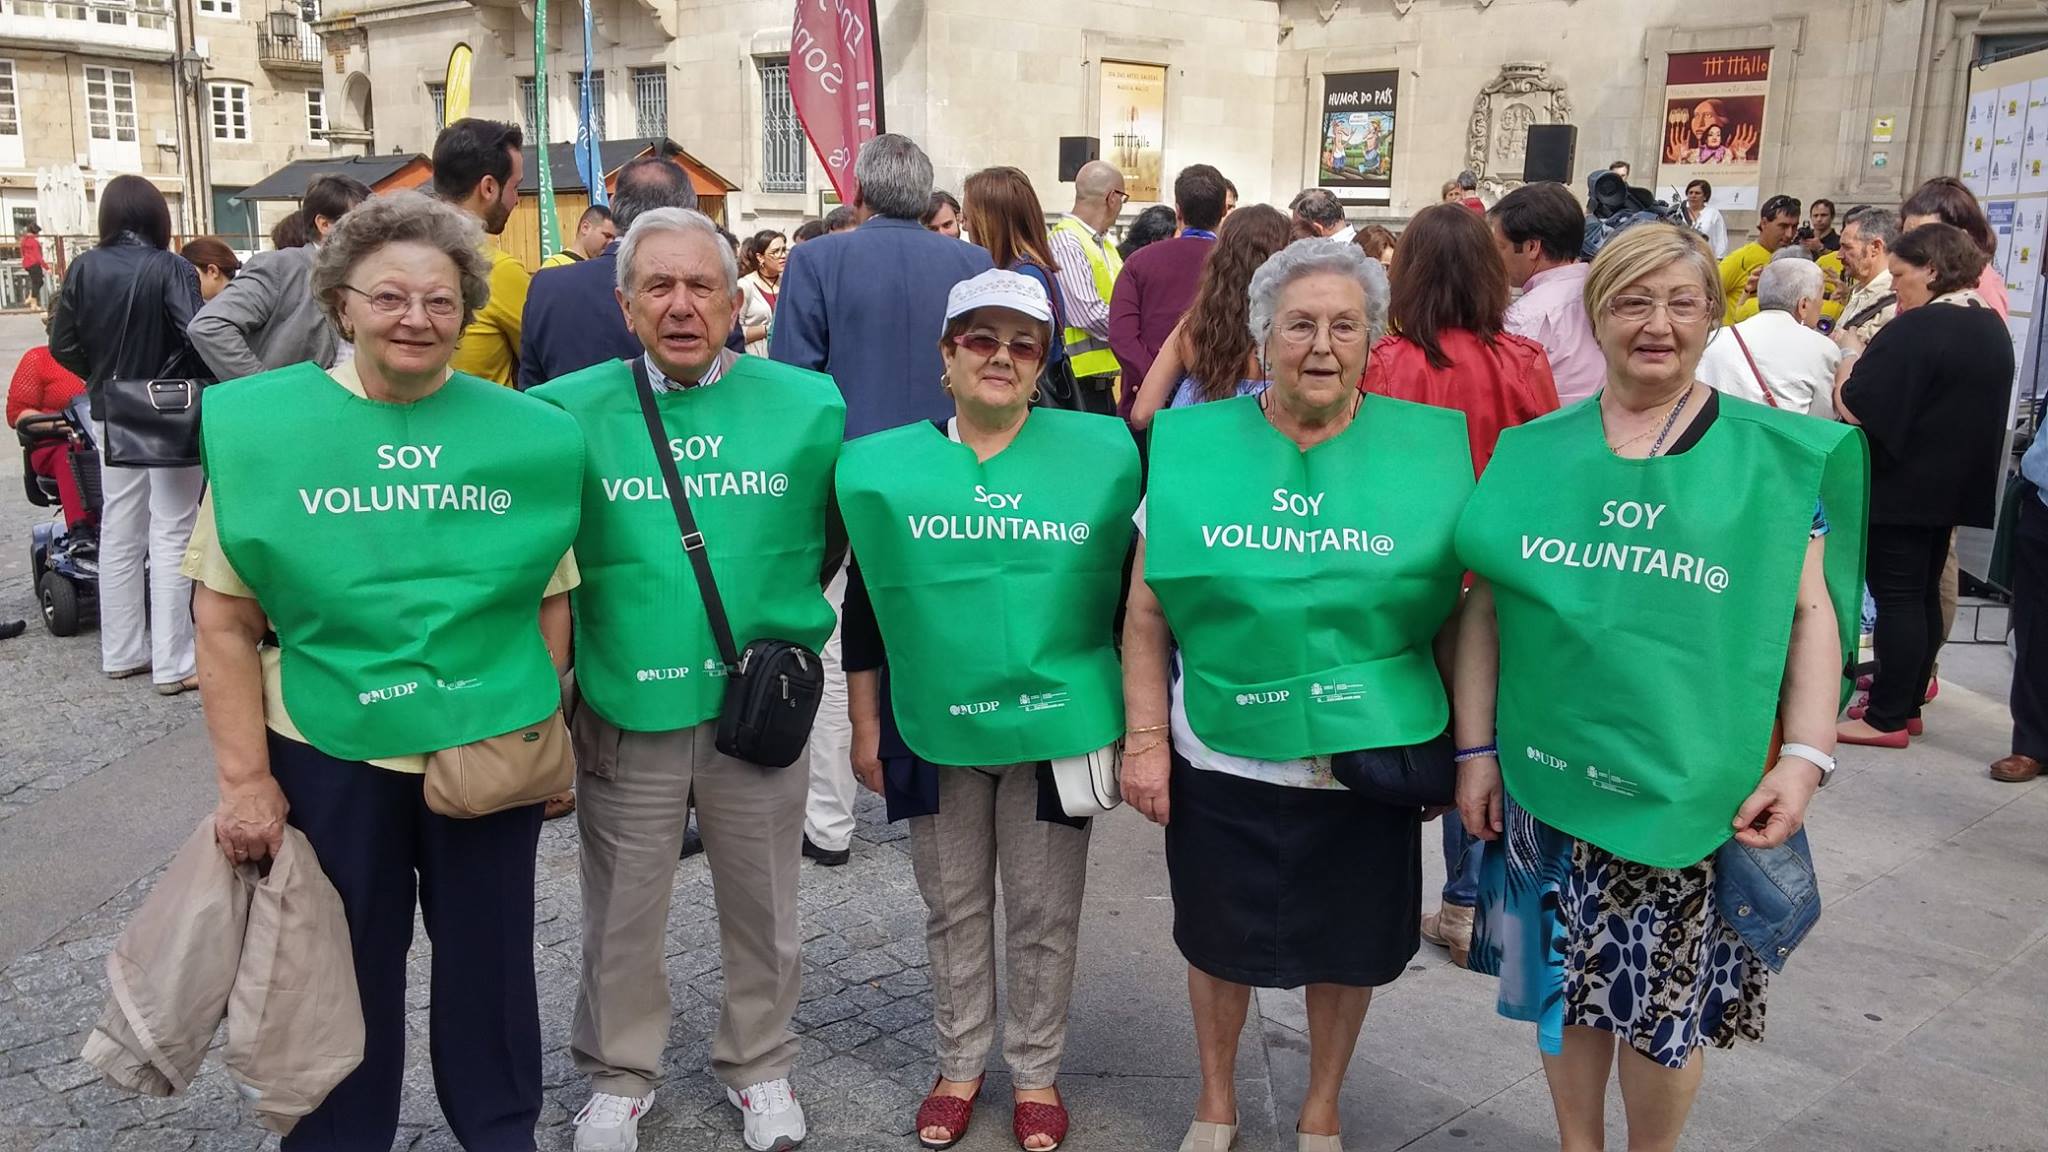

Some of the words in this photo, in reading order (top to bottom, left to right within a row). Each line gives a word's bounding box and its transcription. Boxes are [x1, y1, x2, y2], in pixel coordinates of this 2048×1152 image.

[1328, 90, 1359, 106] HUMOR
[1360, 91, 1372, 105] DO
[376, 444, 443, 470] SOY
[668, 435, 724, 462] SOY
[298, 483, 512, 515] VOLUNTARI@
[973, 484, 1023, 510] SOY
[1271, 487, 1326, 517] SOY
[1598, 499, 1667, 531] SOY
[907, 515, 1090, 546] VOLUNTARI@
[1201, 523, 1395, 557] VOLUNTARI@
[1520, 534, 1730, 594] VOLUNTARI@
[655, 667, 689, 680] UDP
[378, 681, 418, 701] UDP
[1255, 689, 1290, 704] UDP
[967, 700, 1000, 715] UDP
[1540, 750, 1568, 772] UDP
